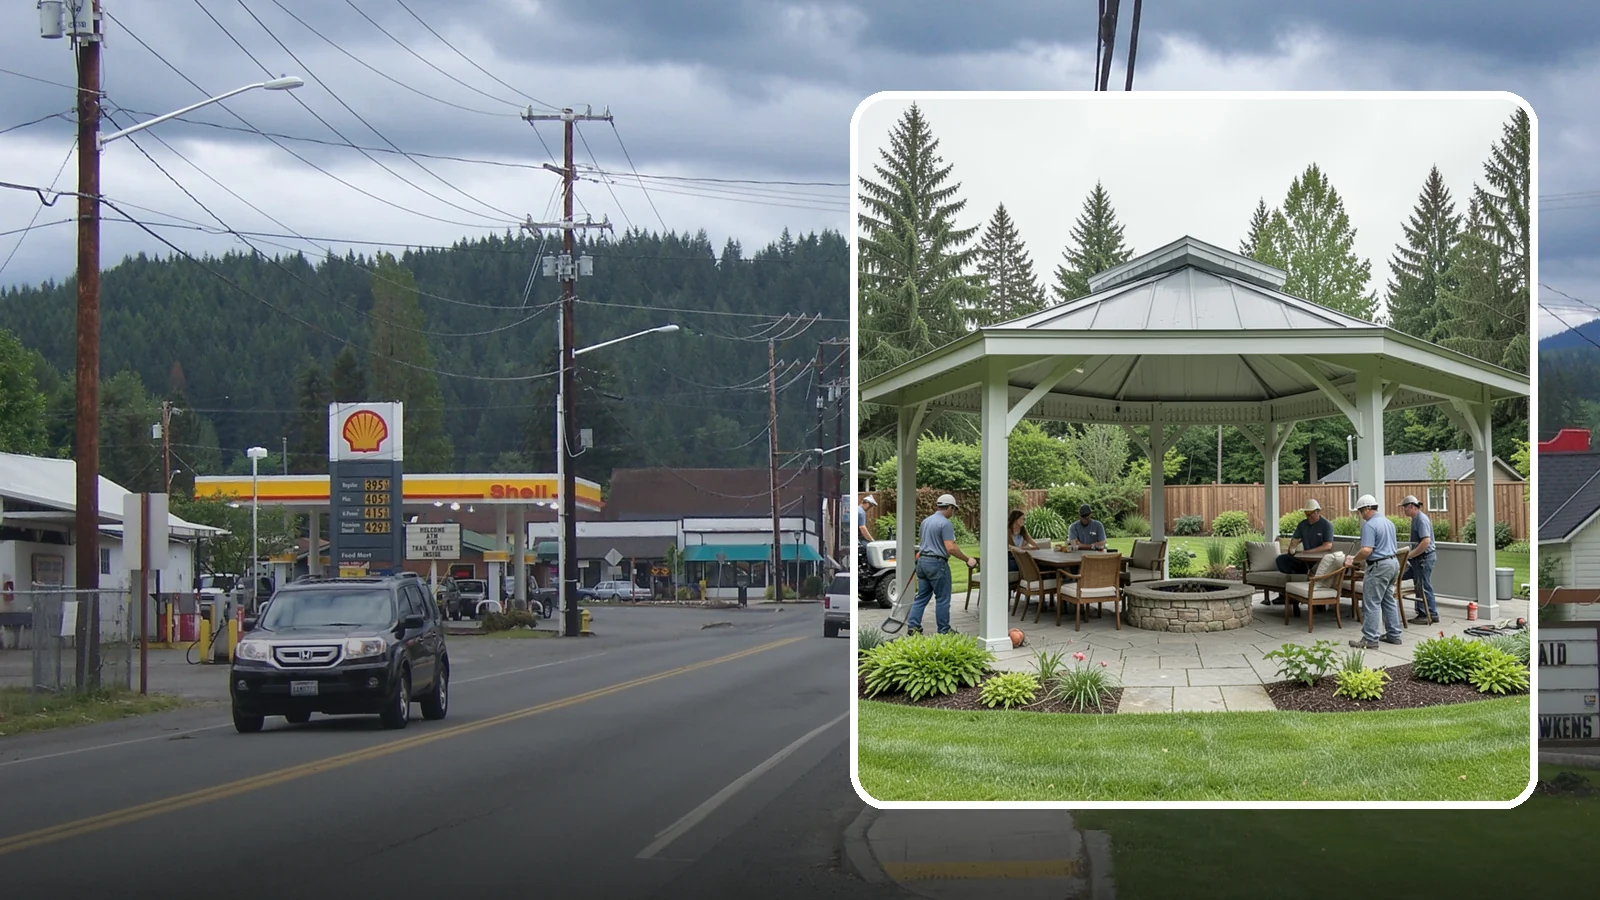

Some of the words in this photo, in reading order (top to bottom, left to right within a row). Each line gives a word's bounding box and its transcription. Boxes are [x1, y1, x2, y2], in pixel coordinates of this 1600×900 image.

[366, 480, 384, 490] 395
[490, 484, 547, 499] Shell
[366, 494, 384, 504] 405
[366, 508, 384, 518] 415
[366, 522, 384, 532] 429
[1539, 643, 1566, 665] AID
